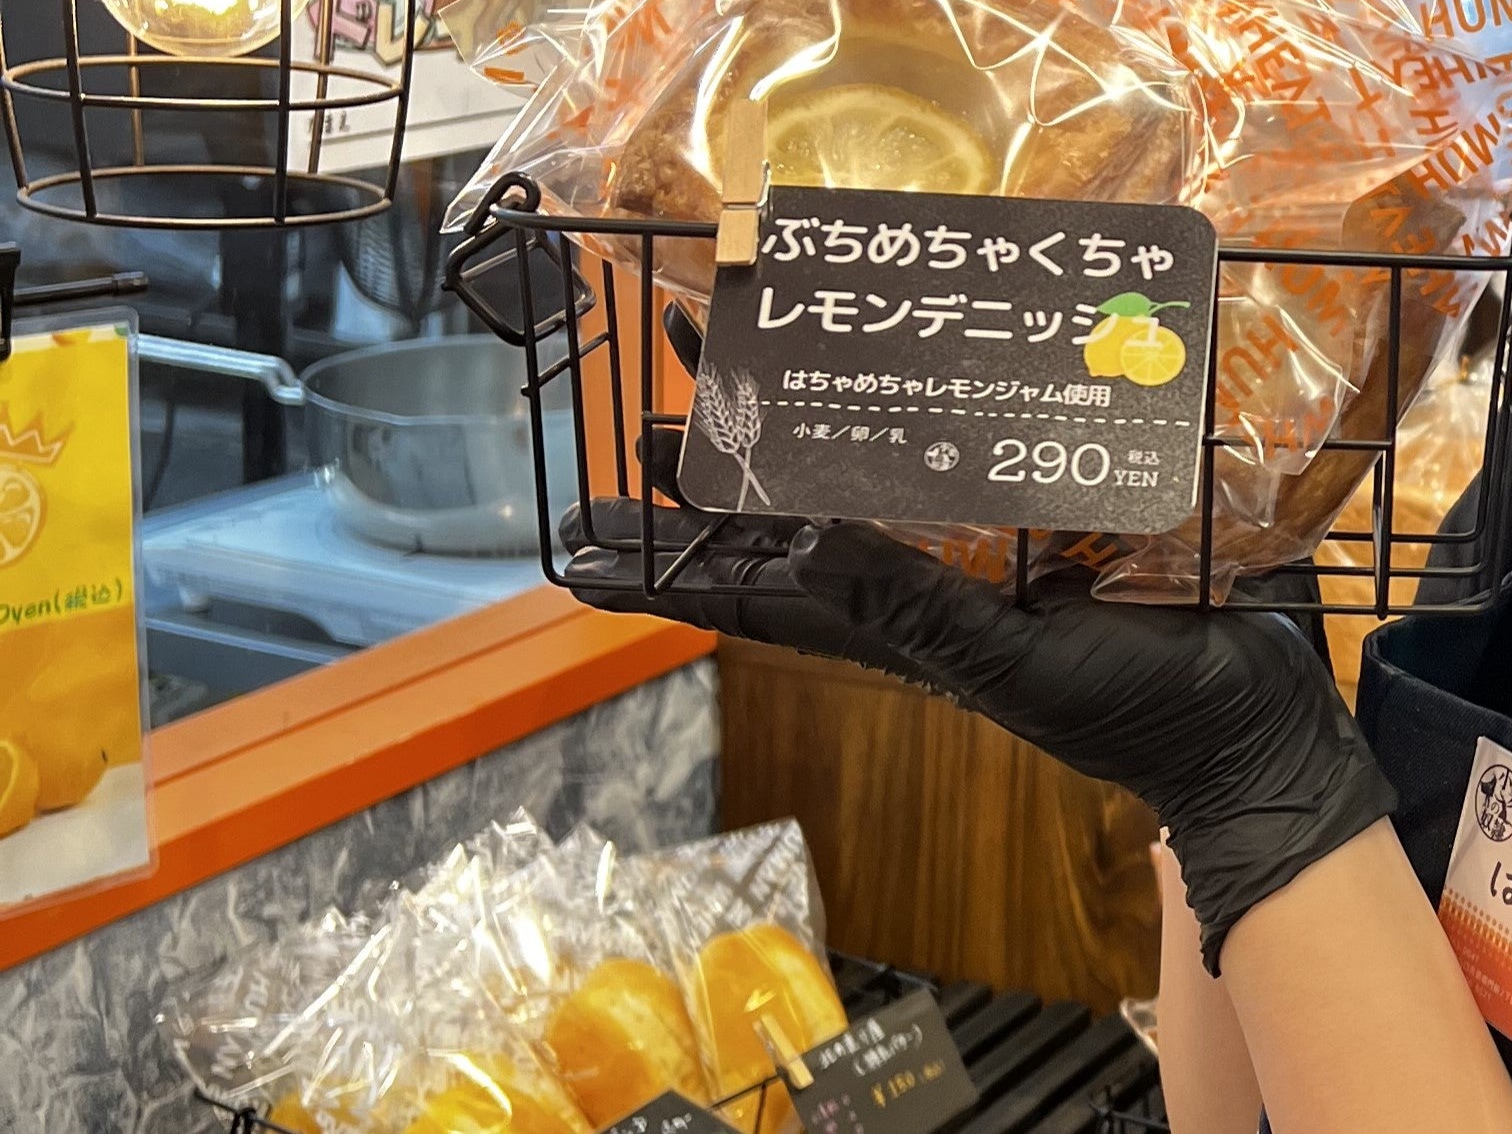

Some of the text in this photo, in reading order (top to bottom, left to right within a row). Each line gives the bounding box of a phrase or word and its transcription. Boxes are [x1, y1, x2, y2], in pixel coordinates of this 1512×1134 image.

[761, 216, 1175, 280] ぶちめちゃくちゃ
[757, 286, 1164, 348] レモンデニッシュ
[782, 368, 1113, 408] はちゃめちゃレモンジャム使用
[987, 438, 1111, 487] 290
[1114, 469, 1160, 487] YEN
[1127, 449, 1161, 466] 税込
